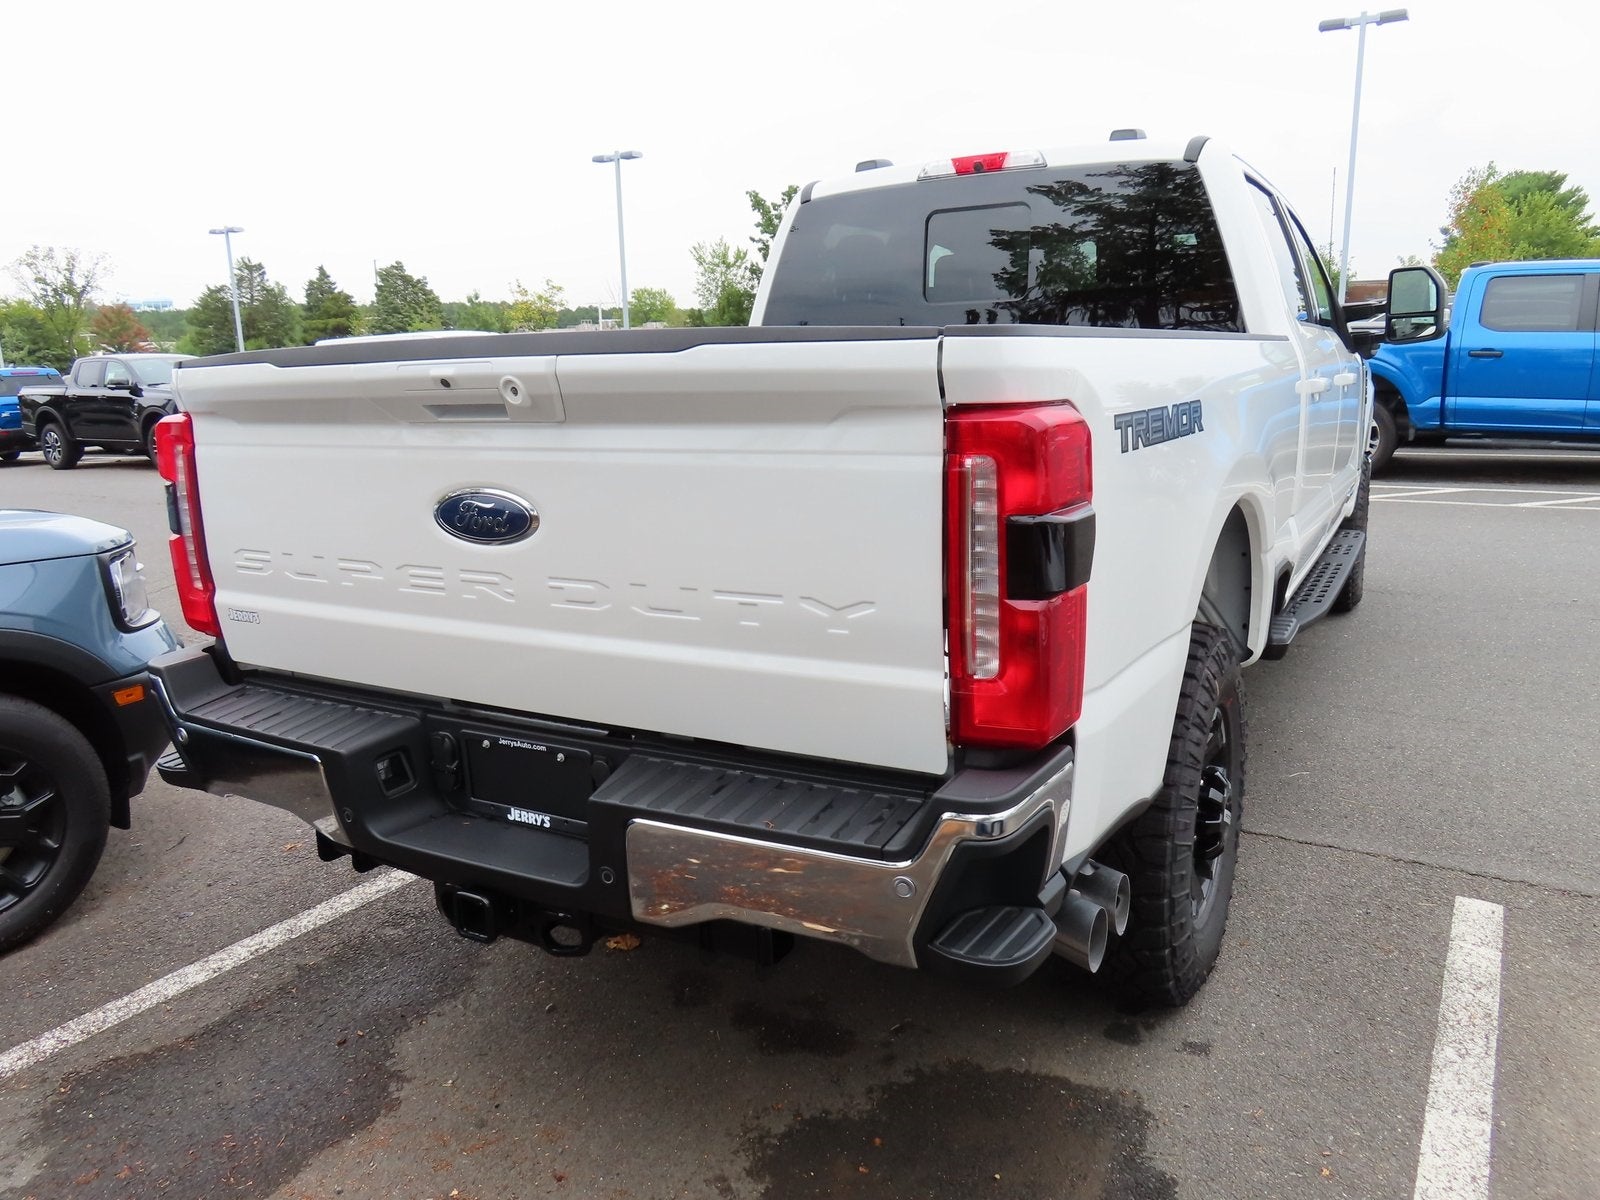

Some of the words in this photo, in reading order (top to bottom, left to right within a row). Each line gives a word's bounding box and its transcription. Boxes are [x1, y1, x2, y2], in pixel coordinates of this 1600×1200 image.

[1114, 399, 1204, 454] TREMOR
[456, 499, 510, 533] Ford
[234, 548, 516, 603] SUPER
[548, 576, 877, 633] DUTY
[498, 737, 547, 752] JerrysAuto.com
[507, 807, 551, 828] JERRY'S
